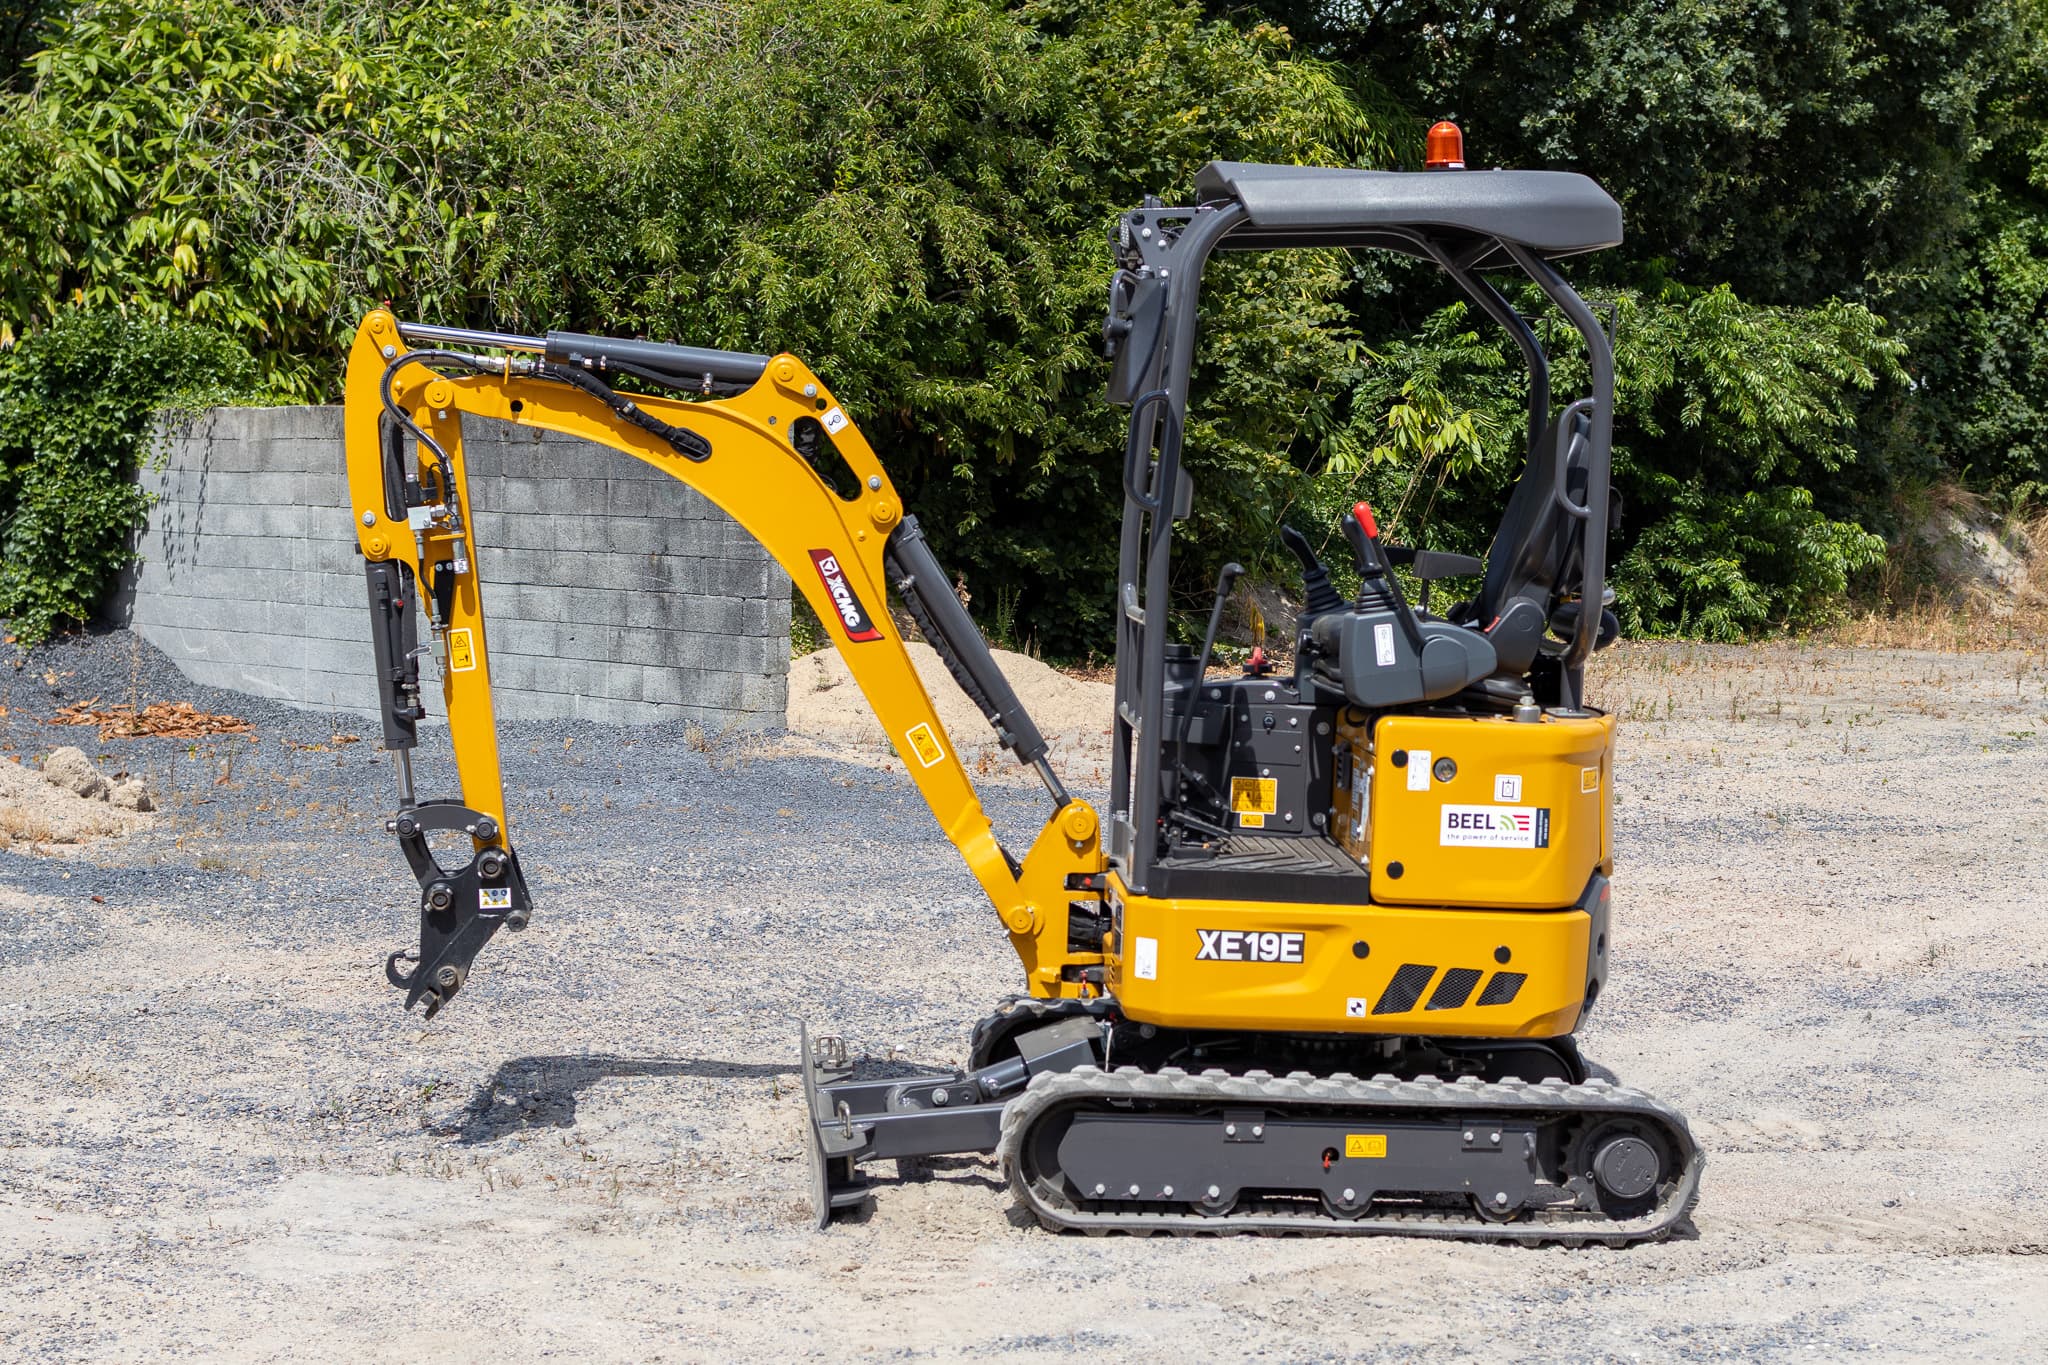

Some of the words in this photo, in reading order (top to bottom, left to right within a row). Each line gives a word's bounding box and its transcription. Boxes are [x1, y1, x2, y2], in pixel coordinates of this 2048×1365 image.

[825, 574, 860, 627] XCMG
[1448, 812, 1495, 830] BEEL
[1196, 929, 1304, 962] XE19E
